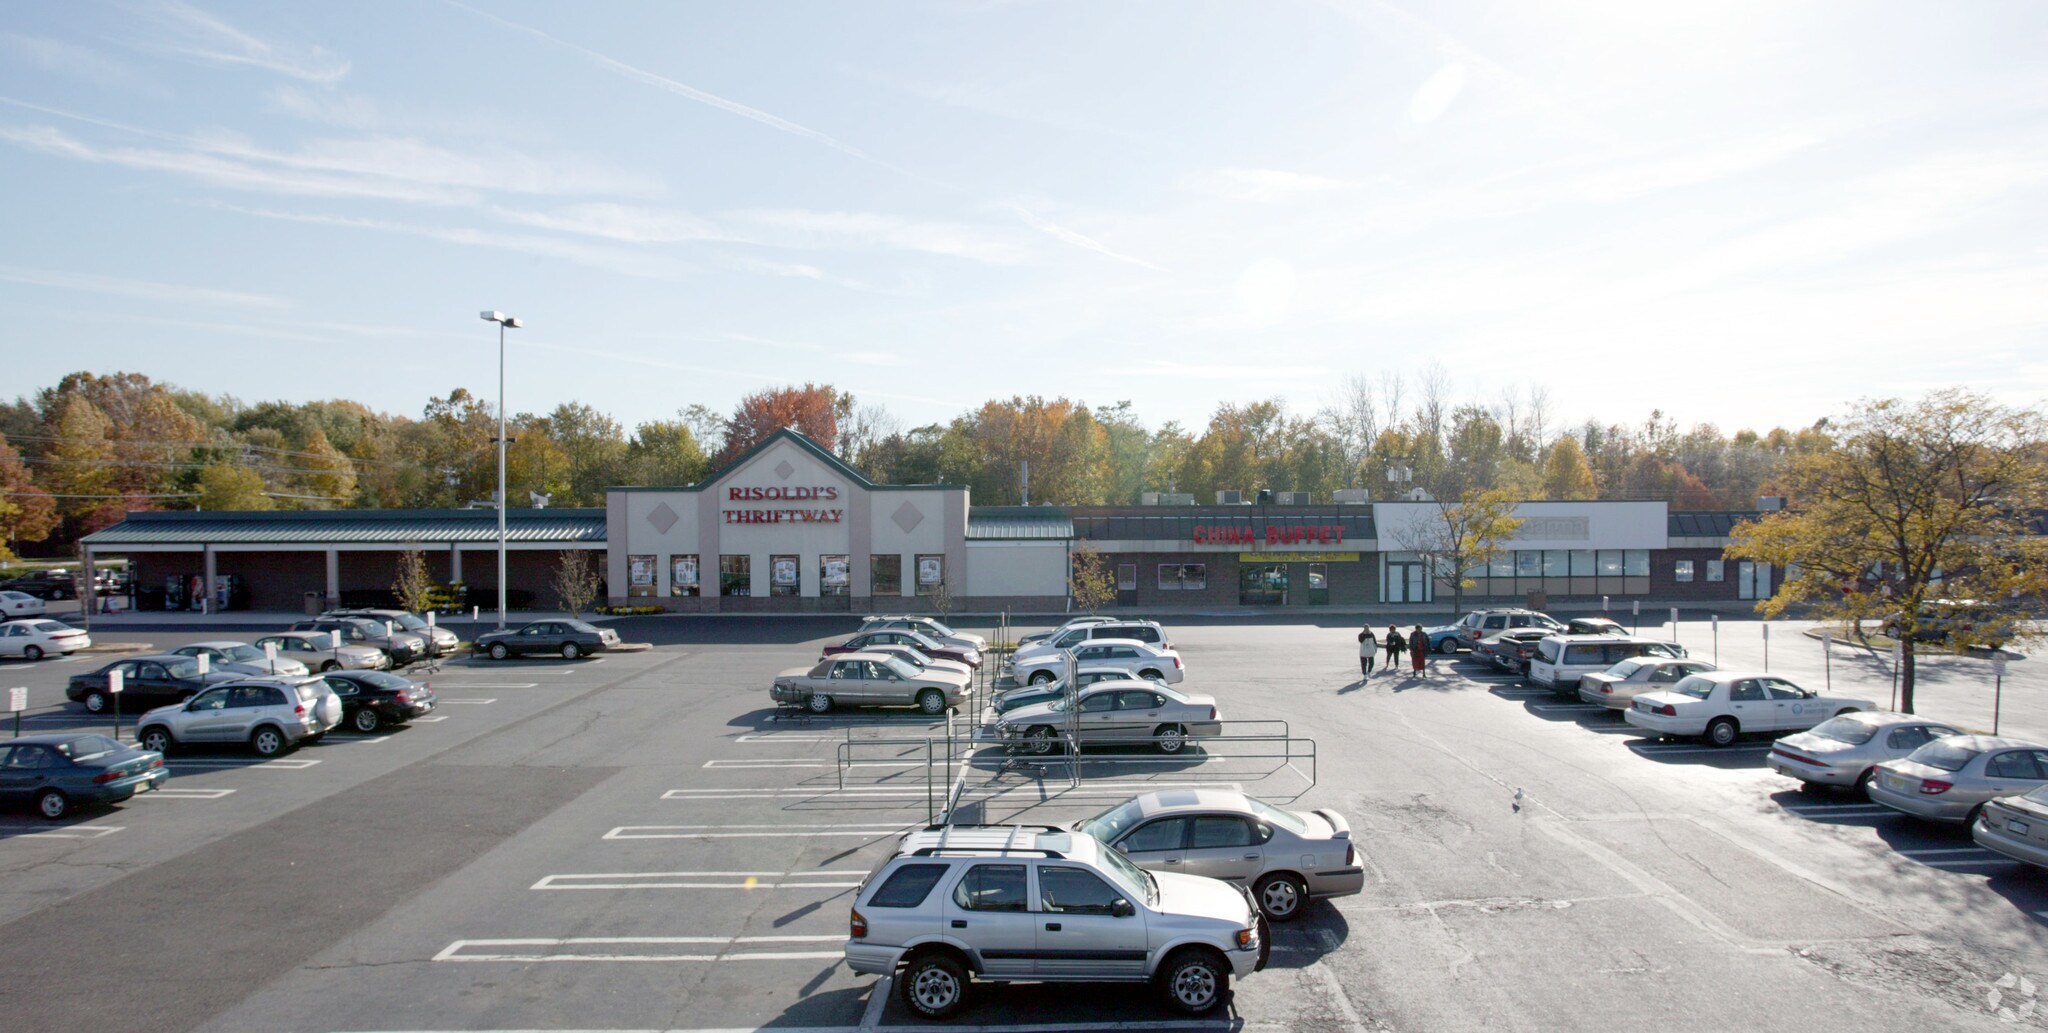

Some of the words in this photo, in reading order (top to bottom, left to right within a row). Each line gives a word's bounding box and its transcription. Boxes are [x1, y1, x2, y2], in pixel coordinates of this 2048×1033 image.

[729, 487, 838, 501] RISOLDI'S
[723, 509, 843, 523] THRIFTWAY
[1193, 525, 1255, 545] CHINA
[1266, 525, 1345, 545] BUFFET
